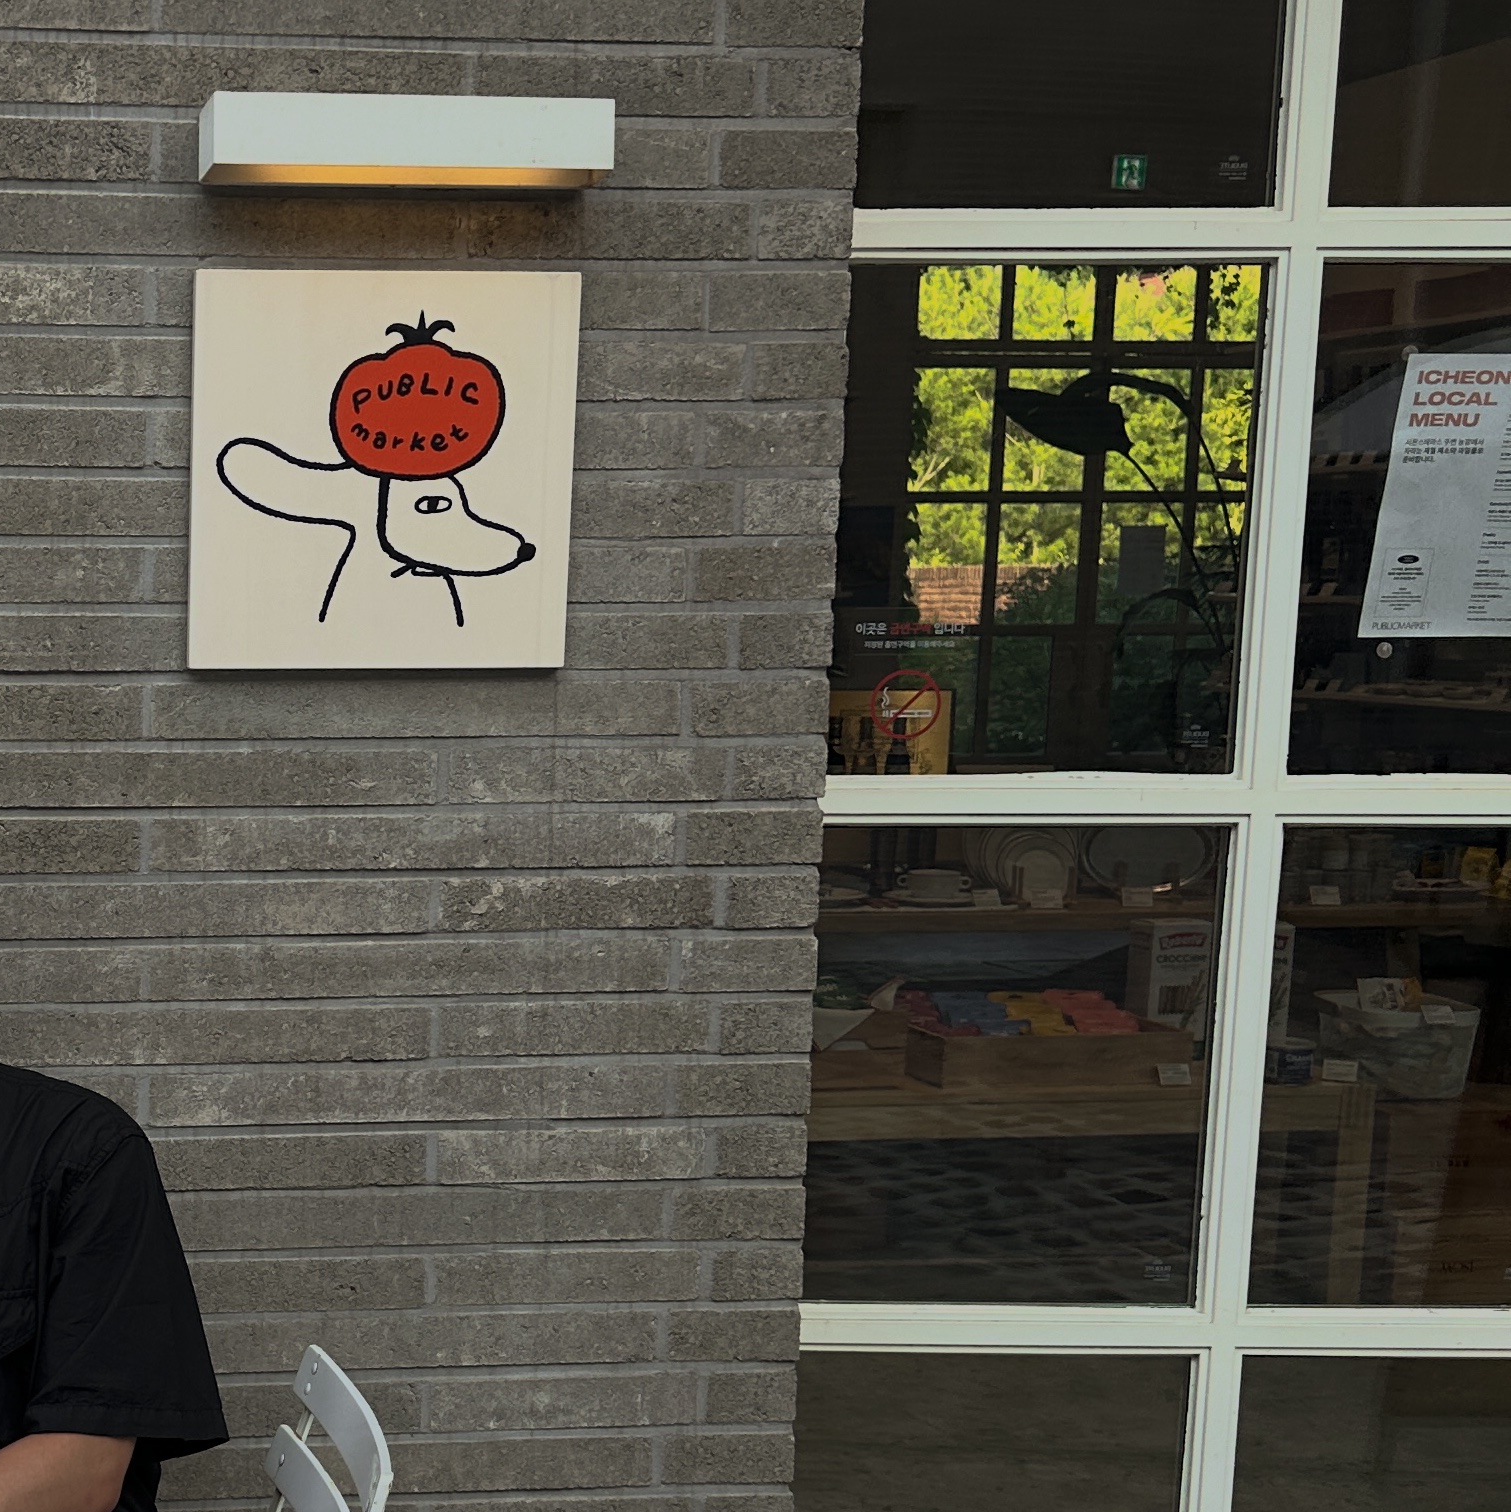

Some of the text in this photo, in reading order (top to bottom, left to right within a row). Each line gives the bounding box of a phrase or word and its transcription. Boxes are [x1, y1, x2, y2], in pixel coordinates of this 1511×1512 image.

[1417, 370, 1511, 385] ICHEON
[352, 372, 479, 414] PUBLIC
[1413, 391, 1498, 407] LOCAL
[1408, 413, 1480, 427] MENU
[351, 422, 470, 453] market
[855, 622, 965, 635] 이곳은 금연구역 입니다
